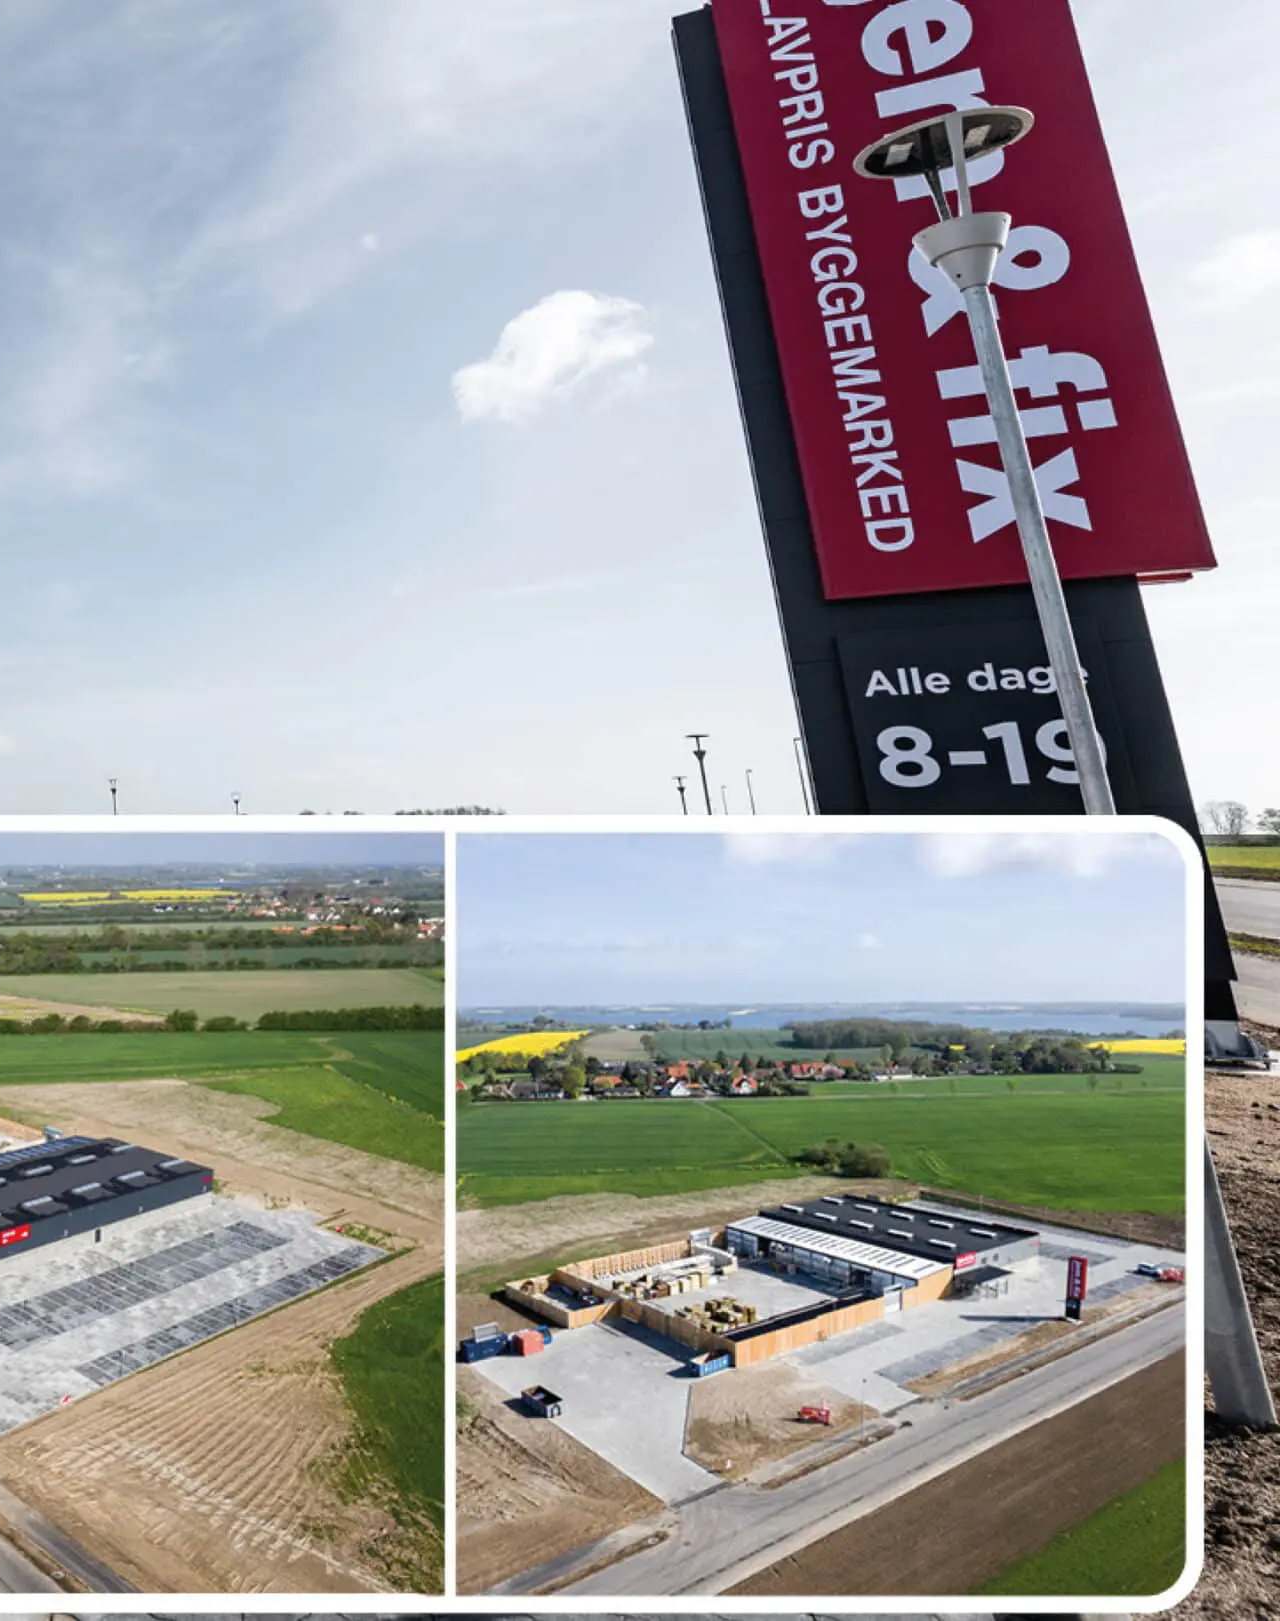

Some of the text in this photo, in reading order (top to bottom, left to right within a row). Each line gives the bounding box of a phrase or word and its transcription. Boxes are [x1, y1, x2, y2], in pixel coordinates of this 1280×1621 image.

[797, 183, 916, 552] BYGGEMARKED
[824, 0, 1006, 203] em
[934, 344, 1119, 544] fix
[865, 662, 1089, 698] Alle dag
[876, 718, 1108, 788] 8-19
